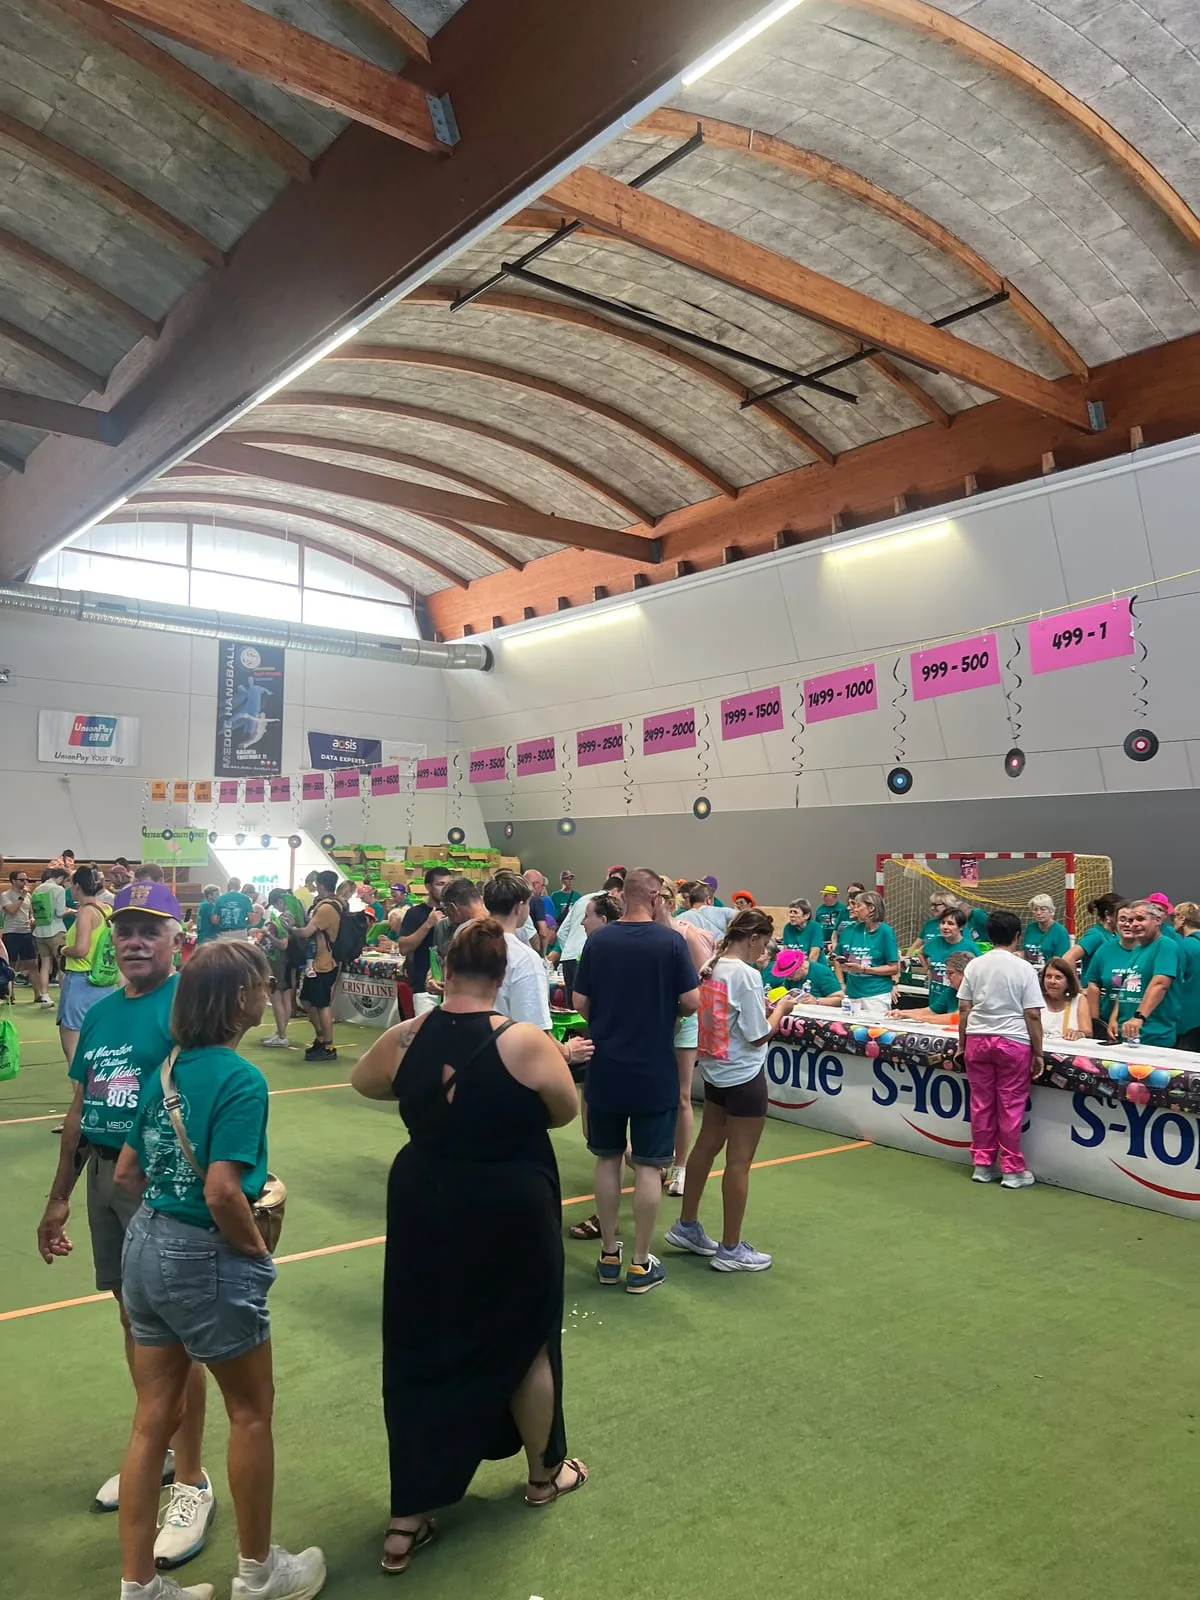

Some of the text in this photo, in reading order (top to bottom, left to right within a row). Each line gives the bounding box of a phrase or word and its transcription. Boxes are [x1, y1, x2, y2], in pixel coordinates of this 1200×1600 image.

[1052, 627, 1083, 650] 499
[1099, 621, 1107, 640] 1
[921, 661, 948, 682] 999
[961, 651, 989, 673] 500
[225, 643, 236, 716] HANDBALL
[808, 688, 835, 708] 1499
[845, 678, 874, 699] 1000
[724, 708, 747, 726] 1999
[755, 700, 780, 719] 1500
[74, 722, 114, 736] UnionPay
[643, 726, 665, 743] 2499
[671, 720, 695, 737] 2000
[577, 740, 597, 755] 2999
[602, 735, 623, 750] 2500
[54, 752, 89, 764] UnionPay
[320, 754, 366, 764] DATA EXPERTS
[342, 980, 394, 997] CRISTALINE
[106, 1089, 139, 1109] 80's
